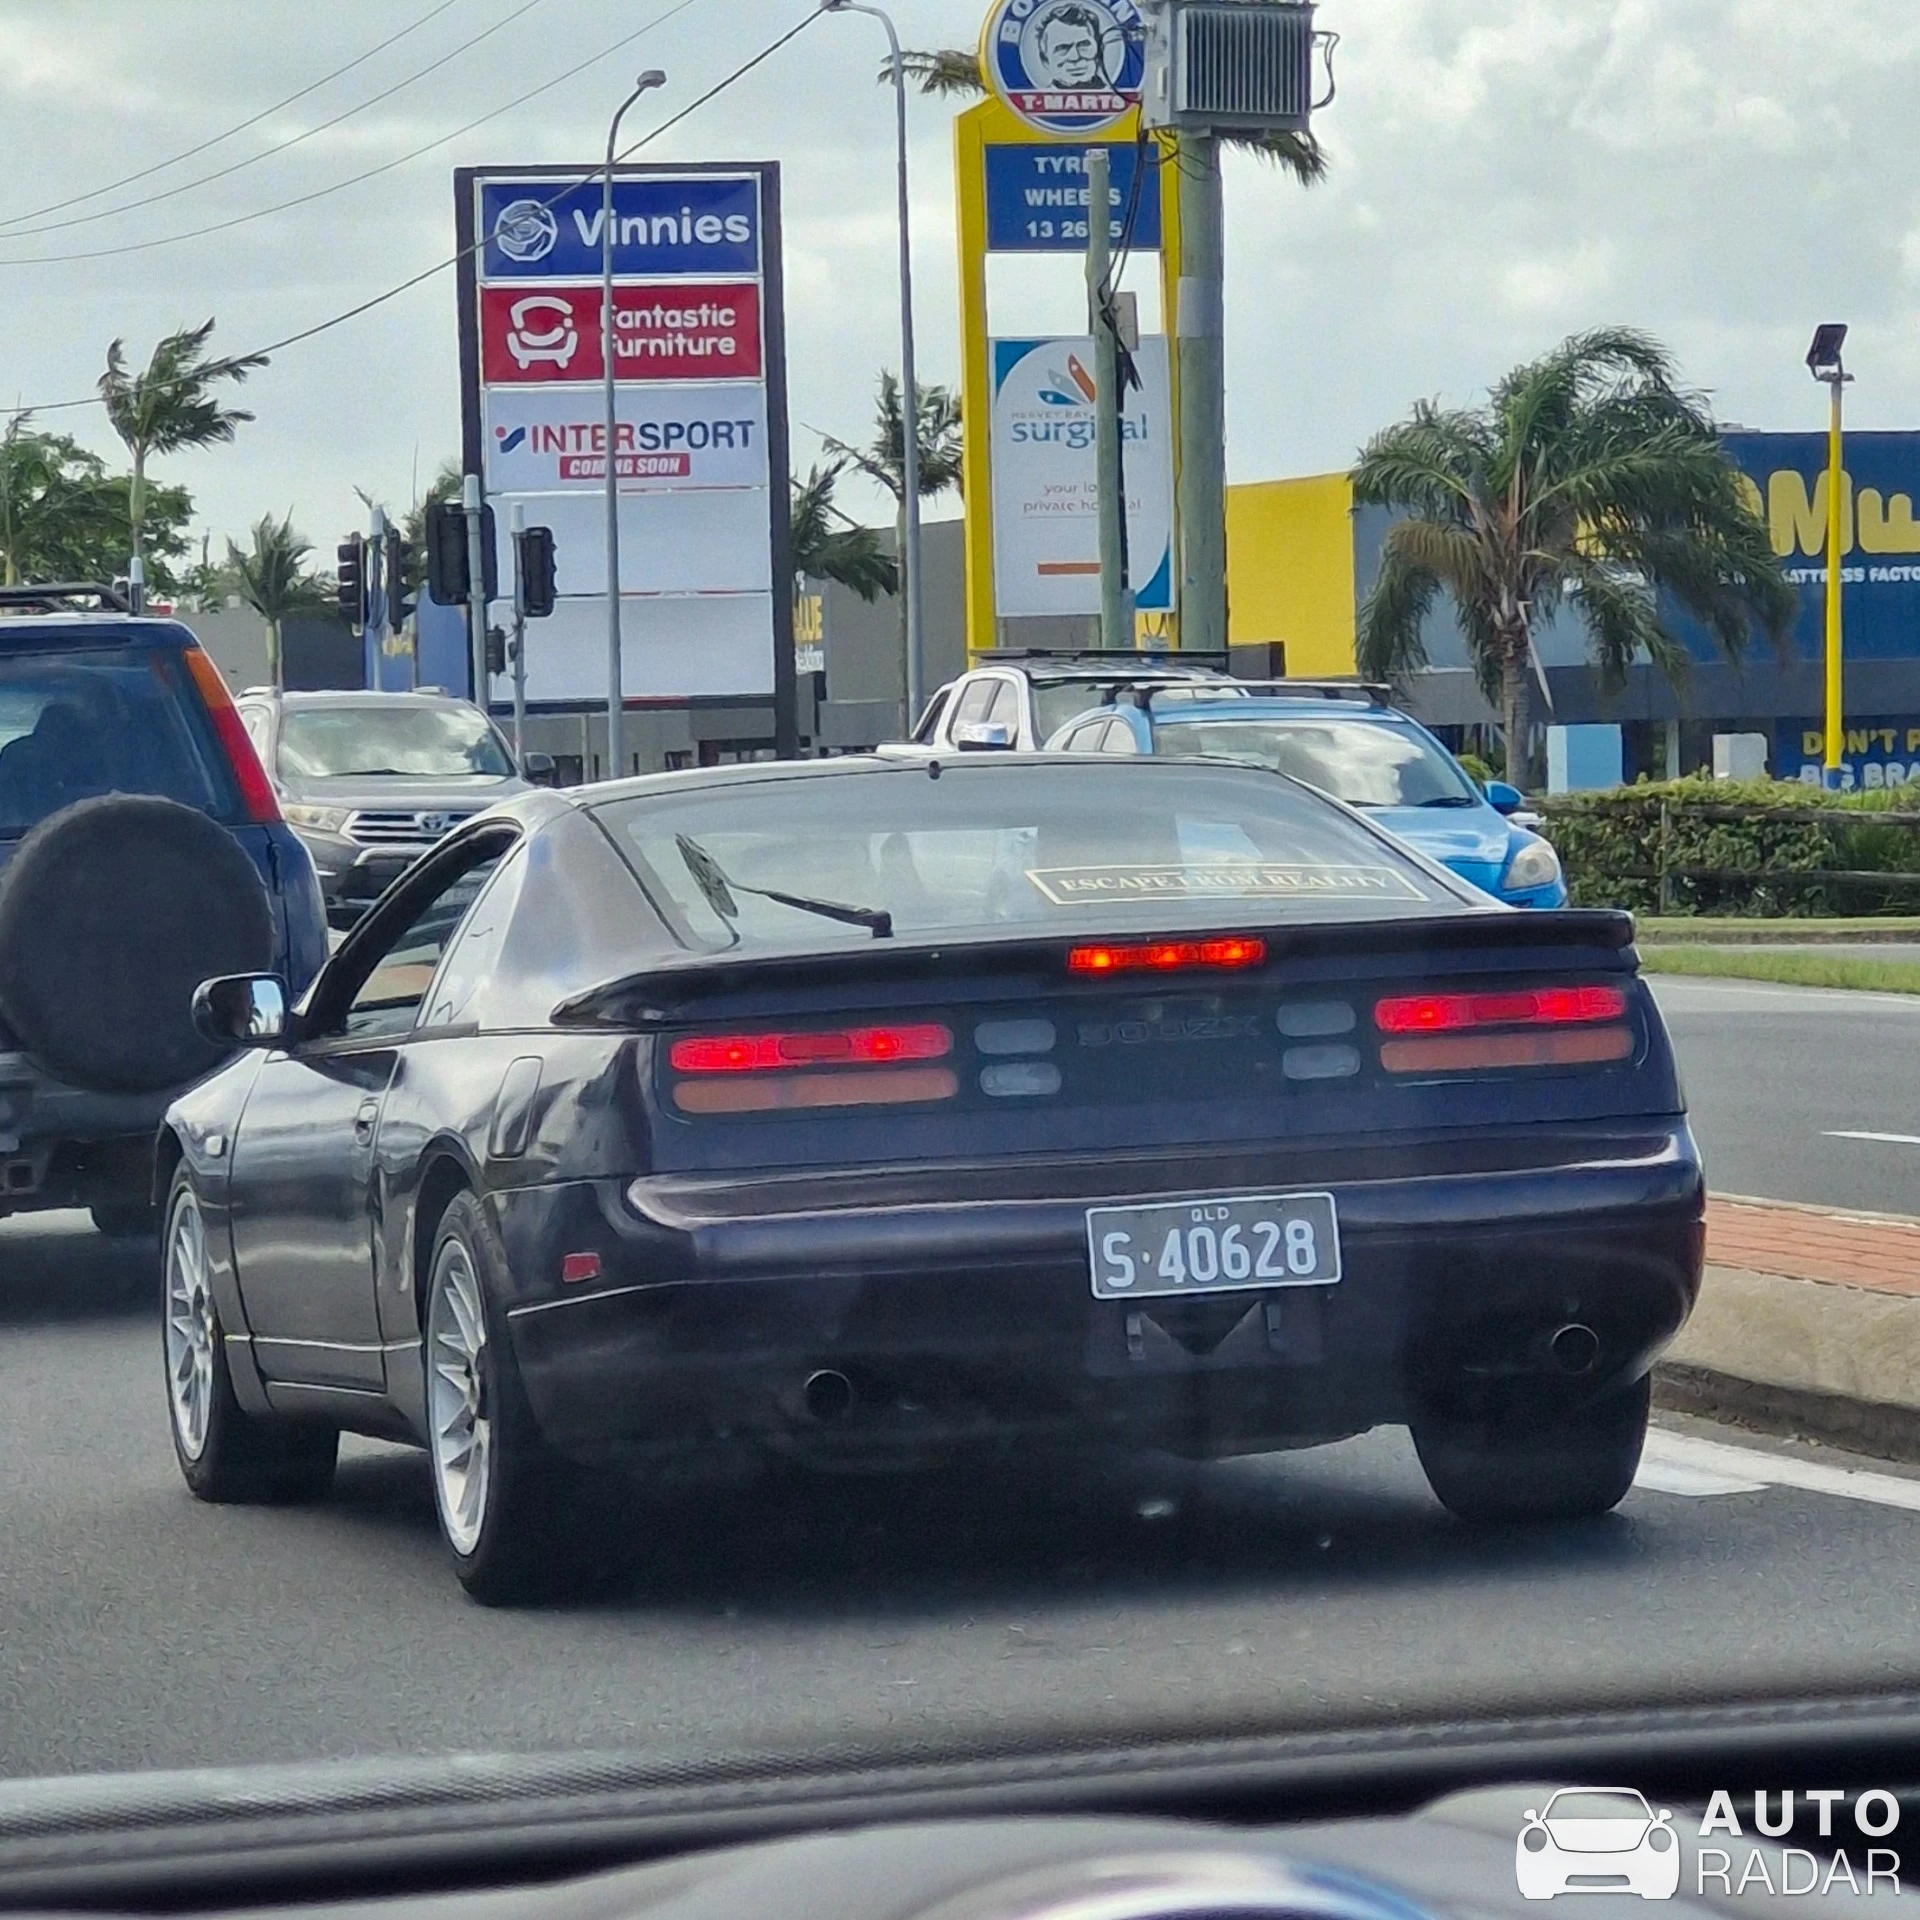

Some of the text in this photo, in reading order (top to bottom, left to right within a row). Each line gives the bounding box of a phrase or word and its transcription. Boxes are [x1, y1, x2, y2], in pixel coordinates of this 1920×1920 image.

[1024, 187, 1121, 206] WHEES
[572, 206, 751, 247] Vinnies
[1026, 220, 1054, 238] 13
[531, 420, 755, 453] INTERSPORT
[1011, 413, 1148, 448] surgial
[569, 457, 681, 476] COMNG SOON
[1043, 483, 1078, 497] your
[1023, 499, 1076, 514] private
[1802, 728, 1898, 755] DN'T
[1800, 762, 1855, 790] BG
[1058, 876, 1174, 892] ESCAPE
[1264, 874, 1388, 889] REALITY
[1191, 1206, 1230, 1222] QLD
